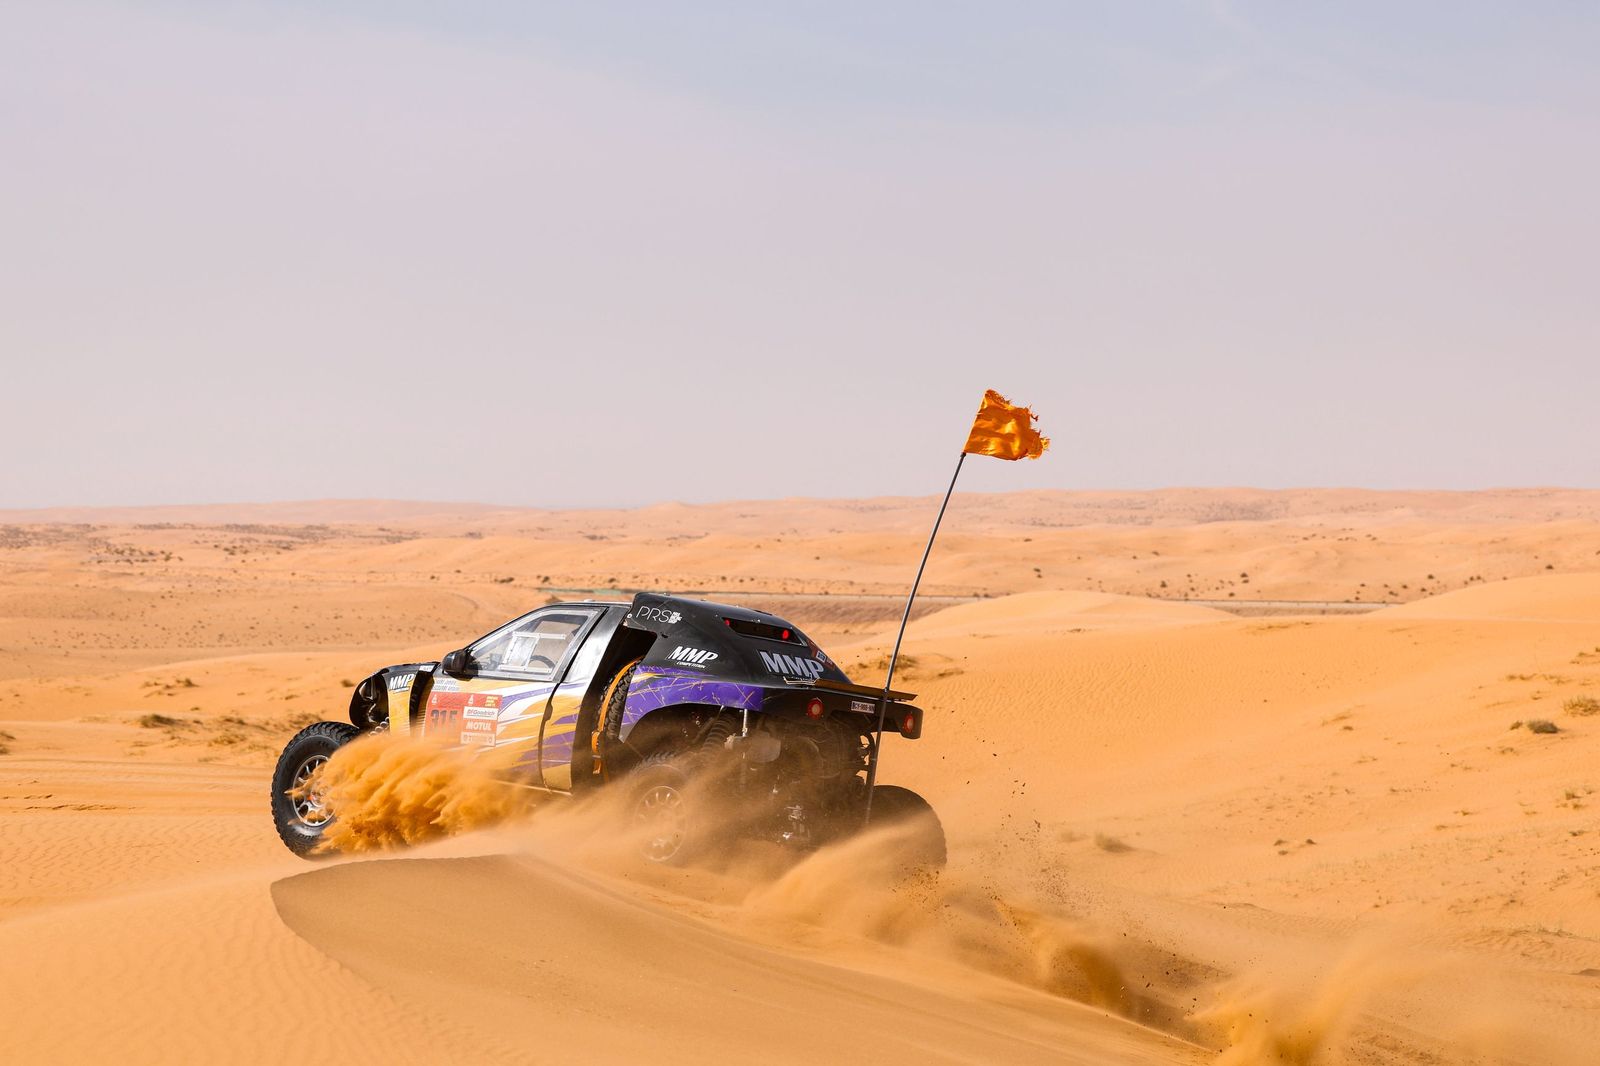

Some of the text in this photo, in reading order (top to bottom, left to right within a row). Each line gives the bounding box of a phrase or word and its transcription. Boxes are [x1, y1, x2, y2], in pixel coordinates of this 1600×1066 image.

[636, 606, 672, 623] PRS
[667, 646, 719, 664] MMP
[759, 651, 824, 680] MMP
[389, 673, 415, 690] MMP
[465, 720, 492, 731] MOTUL
